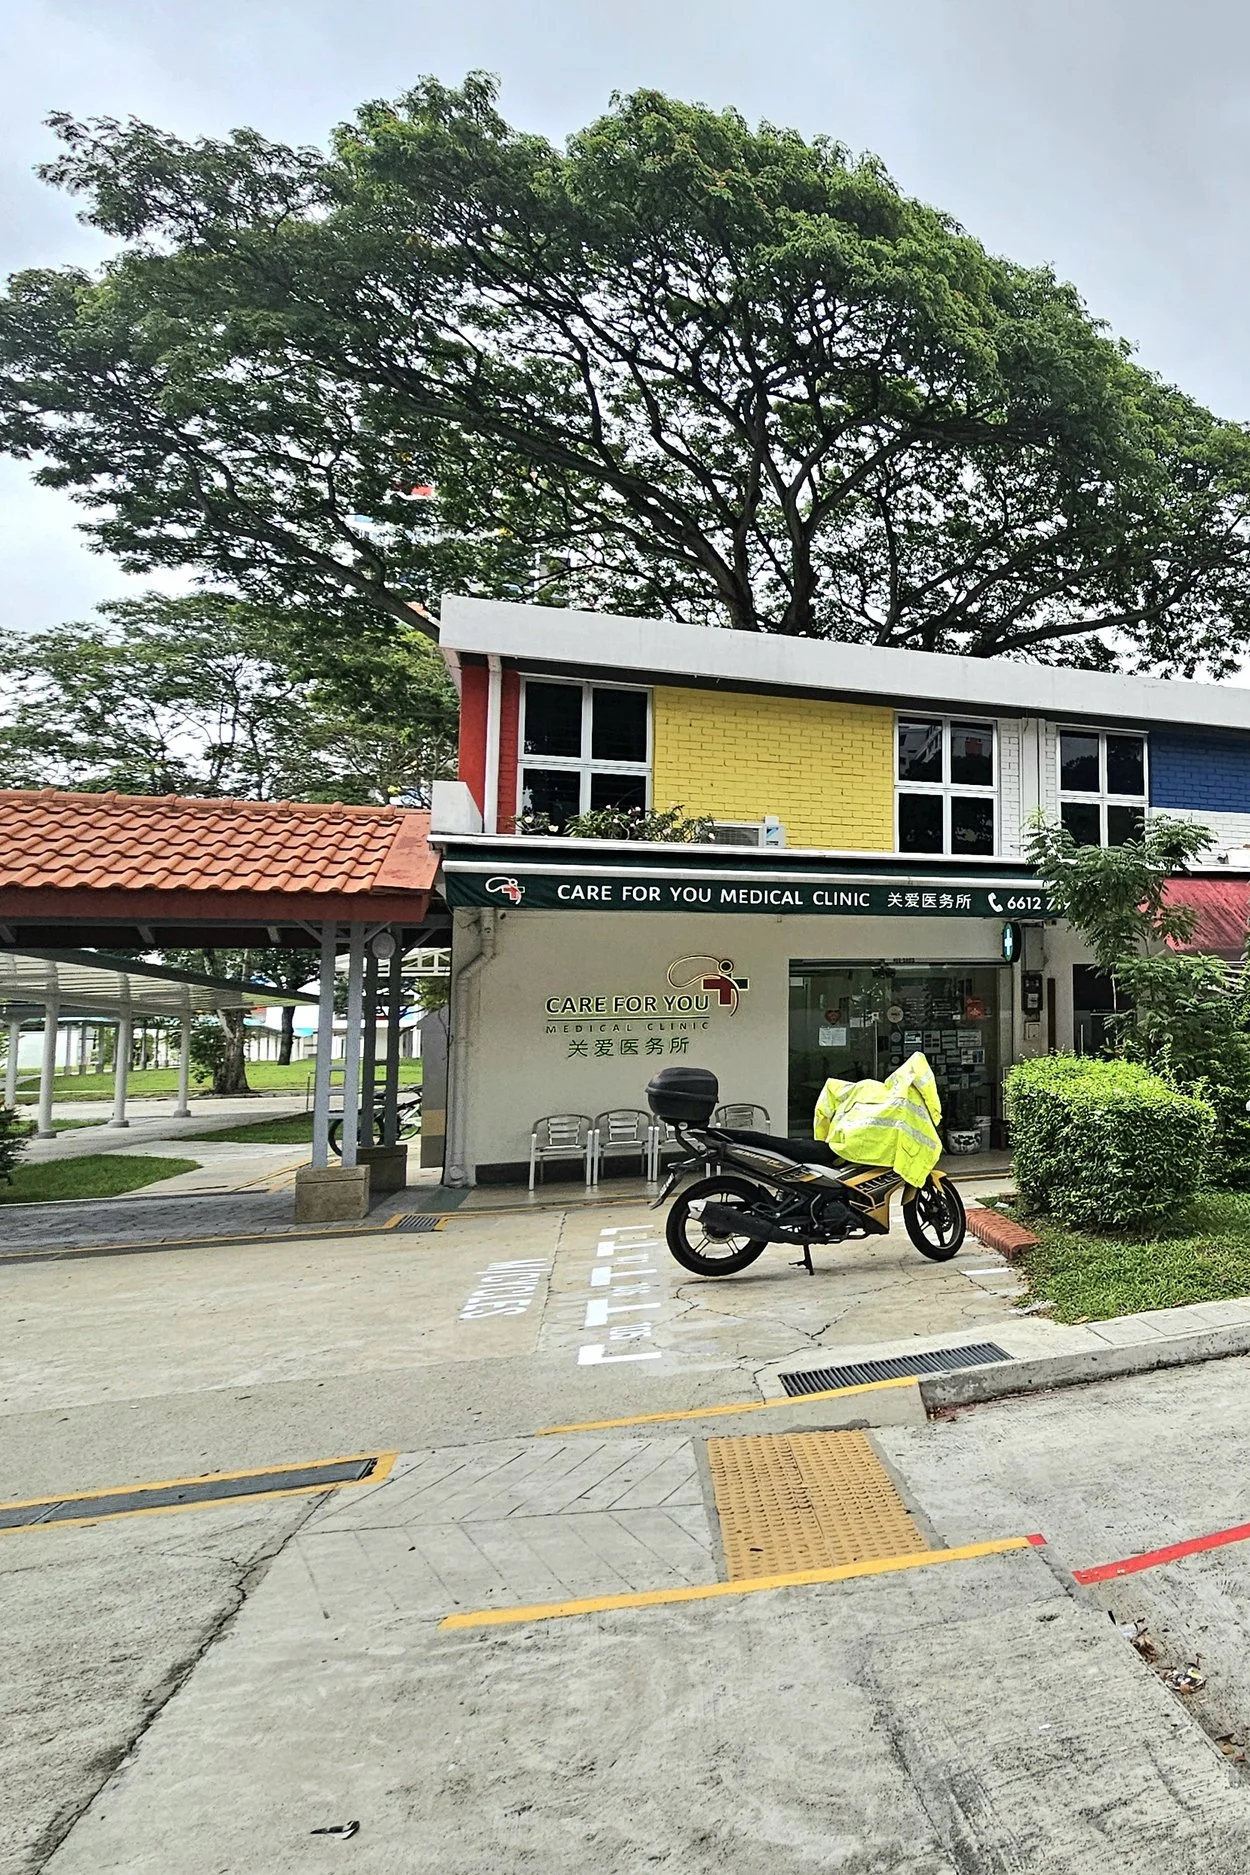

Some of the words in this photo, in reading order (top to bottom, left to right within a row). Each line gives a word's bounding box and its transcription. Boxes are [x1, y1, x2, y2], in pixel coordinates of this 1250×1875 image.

[557, 884, 612, 900] CARE
[622, 886, 661, 901] FOR
[670, 887, 712, 902] YOU
[720, 888, 803, 905] MEDICAL
[812, 891, 870, 907] CLINIC
[887, 892, 972, 910] 关爱医务所
[1007, 896, 1041, 910] 6612
[546, 997, 606, 1014] CARE
[613, 996, 657, 1013] FOR
[664, 995, 709, 1012] YOU
[546, 1024, 632, 1034] MEDICAL
[647, 1021, 710, 1031] CLINIC
[567, 1036, 690, 1058] 关爱医务所
